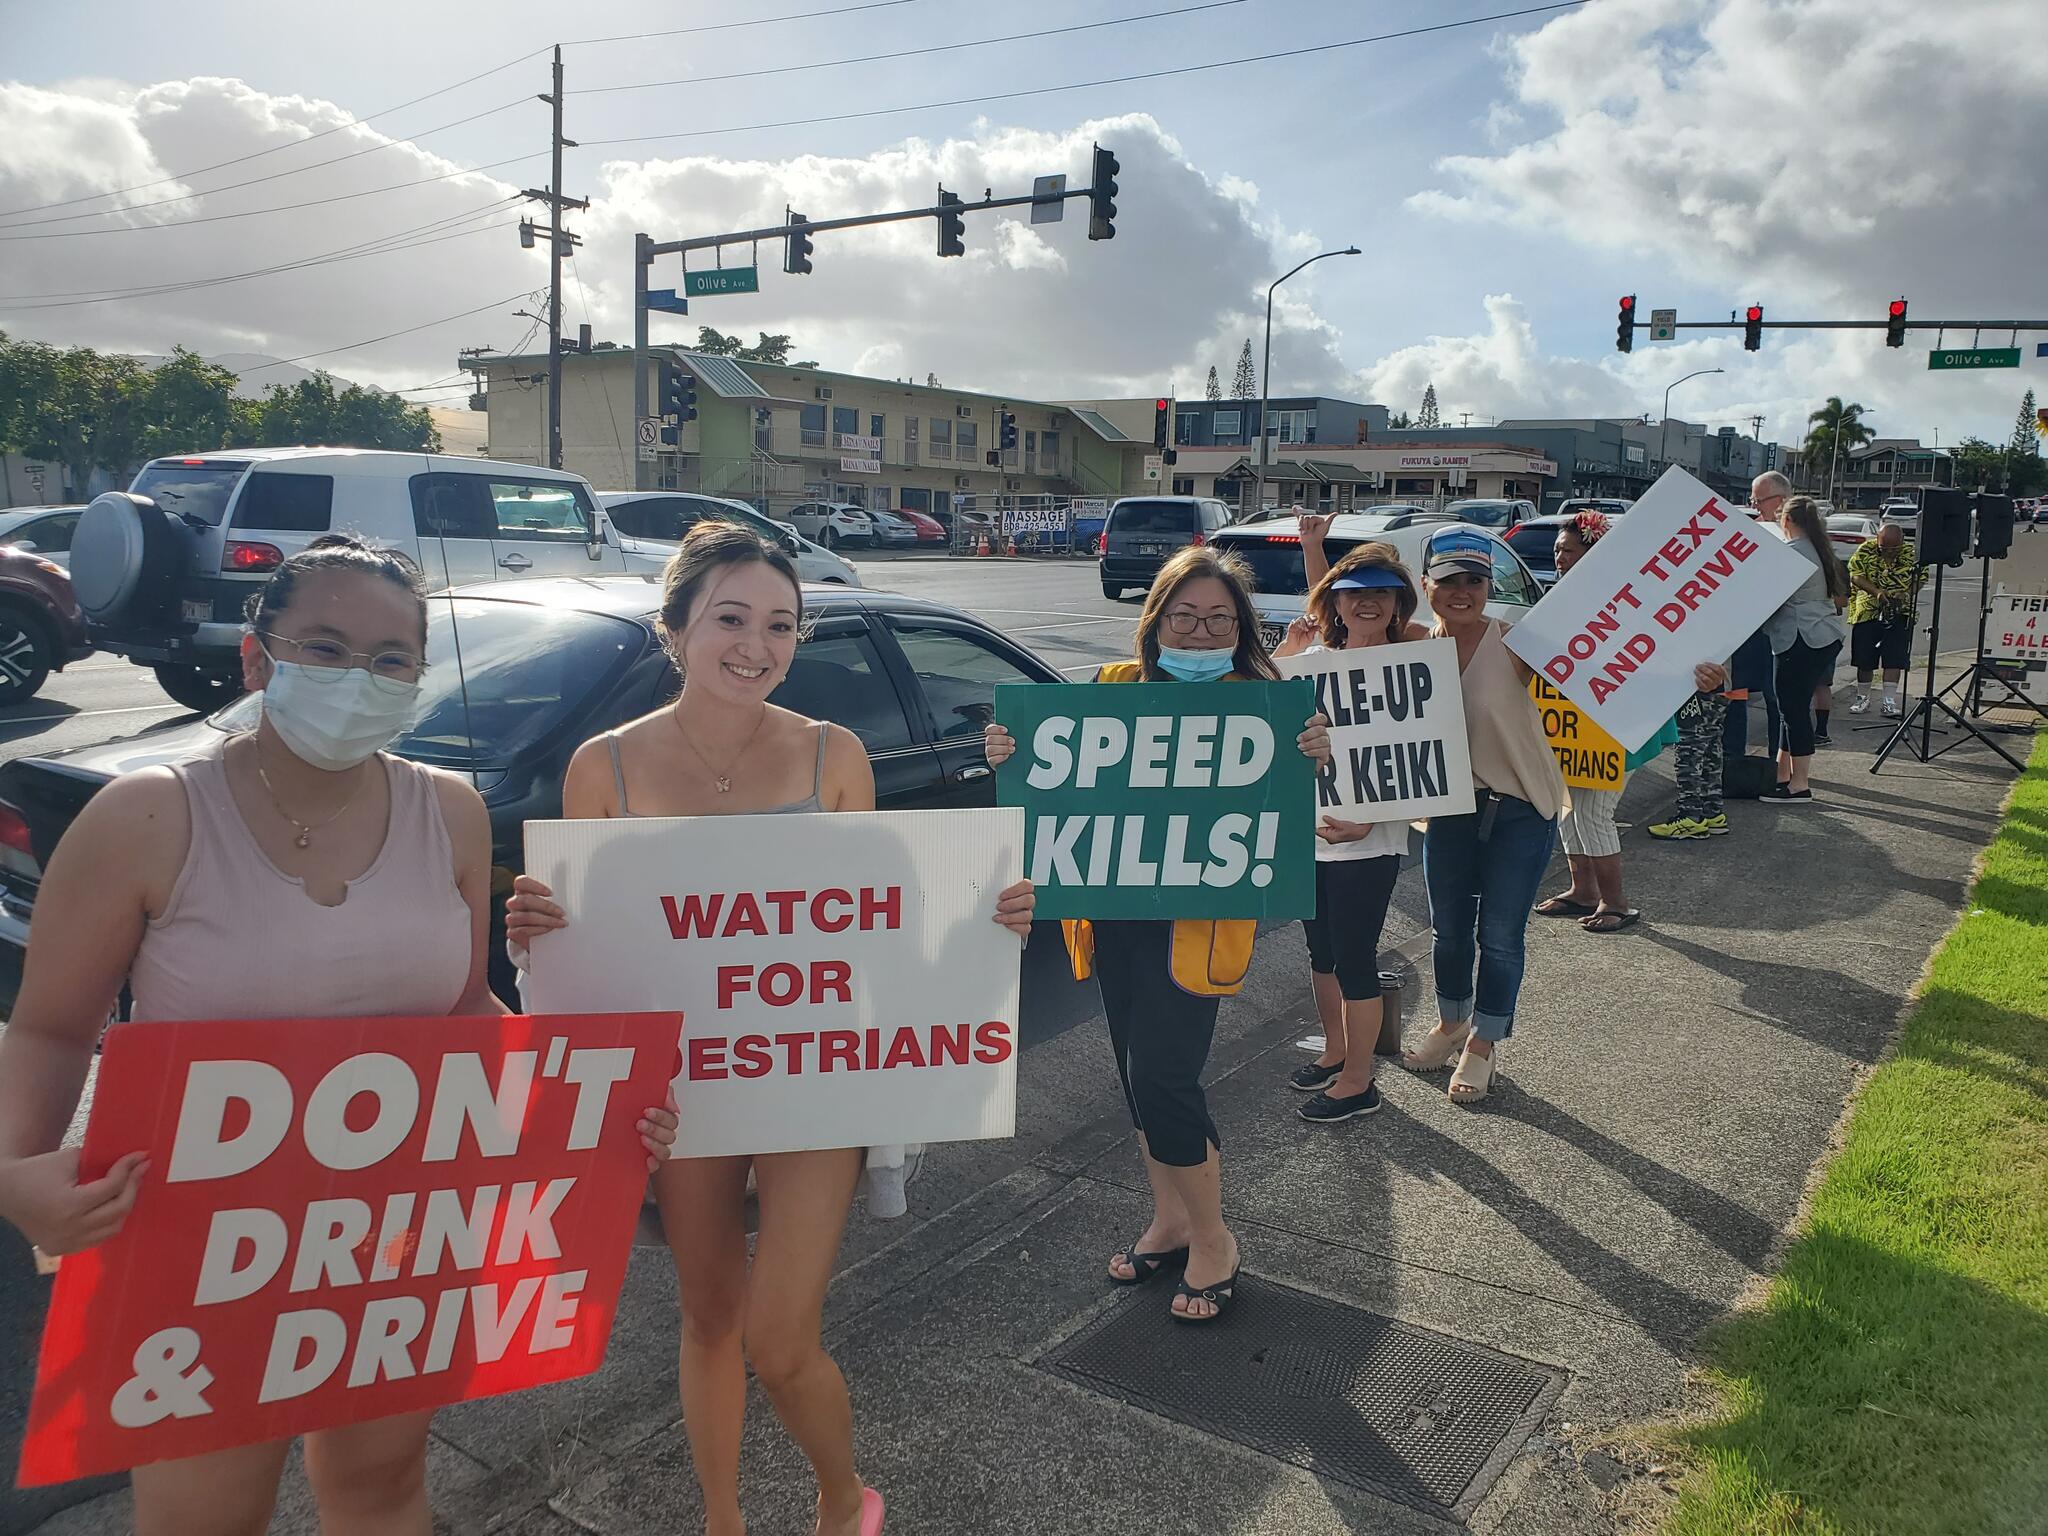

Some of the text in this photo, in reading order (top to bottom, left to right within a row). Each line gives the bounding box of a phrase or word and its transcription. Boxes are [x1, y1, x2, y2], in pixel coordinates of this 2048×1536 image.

[697, 277, 727, 290] Olive
[1944, 354, 1981, 365] Olive
[863, 439, 879, 449] NAILS
[863, 460, 879, 471] NAILS
[1401, 457, 1469, 465] FUKUYA RAMEN
[1003, 522, 1065, 531] 808-425-4551
[1005, 511, 1064, 522] MASSAGE
[1543, 582, 1643, 685] DON'T
[1639, 496, 1728, 582] TEXT
[1588, 530, 1760, 706] AND DRIVE
[2026, 616, 2036, 629] 4
[1290, 662, 1433, 728] KLE-UP
[1026, 715, 1275, 790] SPEED
[1349, 739, 1449, 804] KEIKI
[1030, 811, 1280, 888] KILLS!
[660, 885, 902, 940] WATCH
[717, 960, 853, 1009] FOR
[165, 1036, 636, 1184] DON'T
[193, 1176, 578, 1306] DRINK
[110, 1269, 589, 1429] & DRIVE
